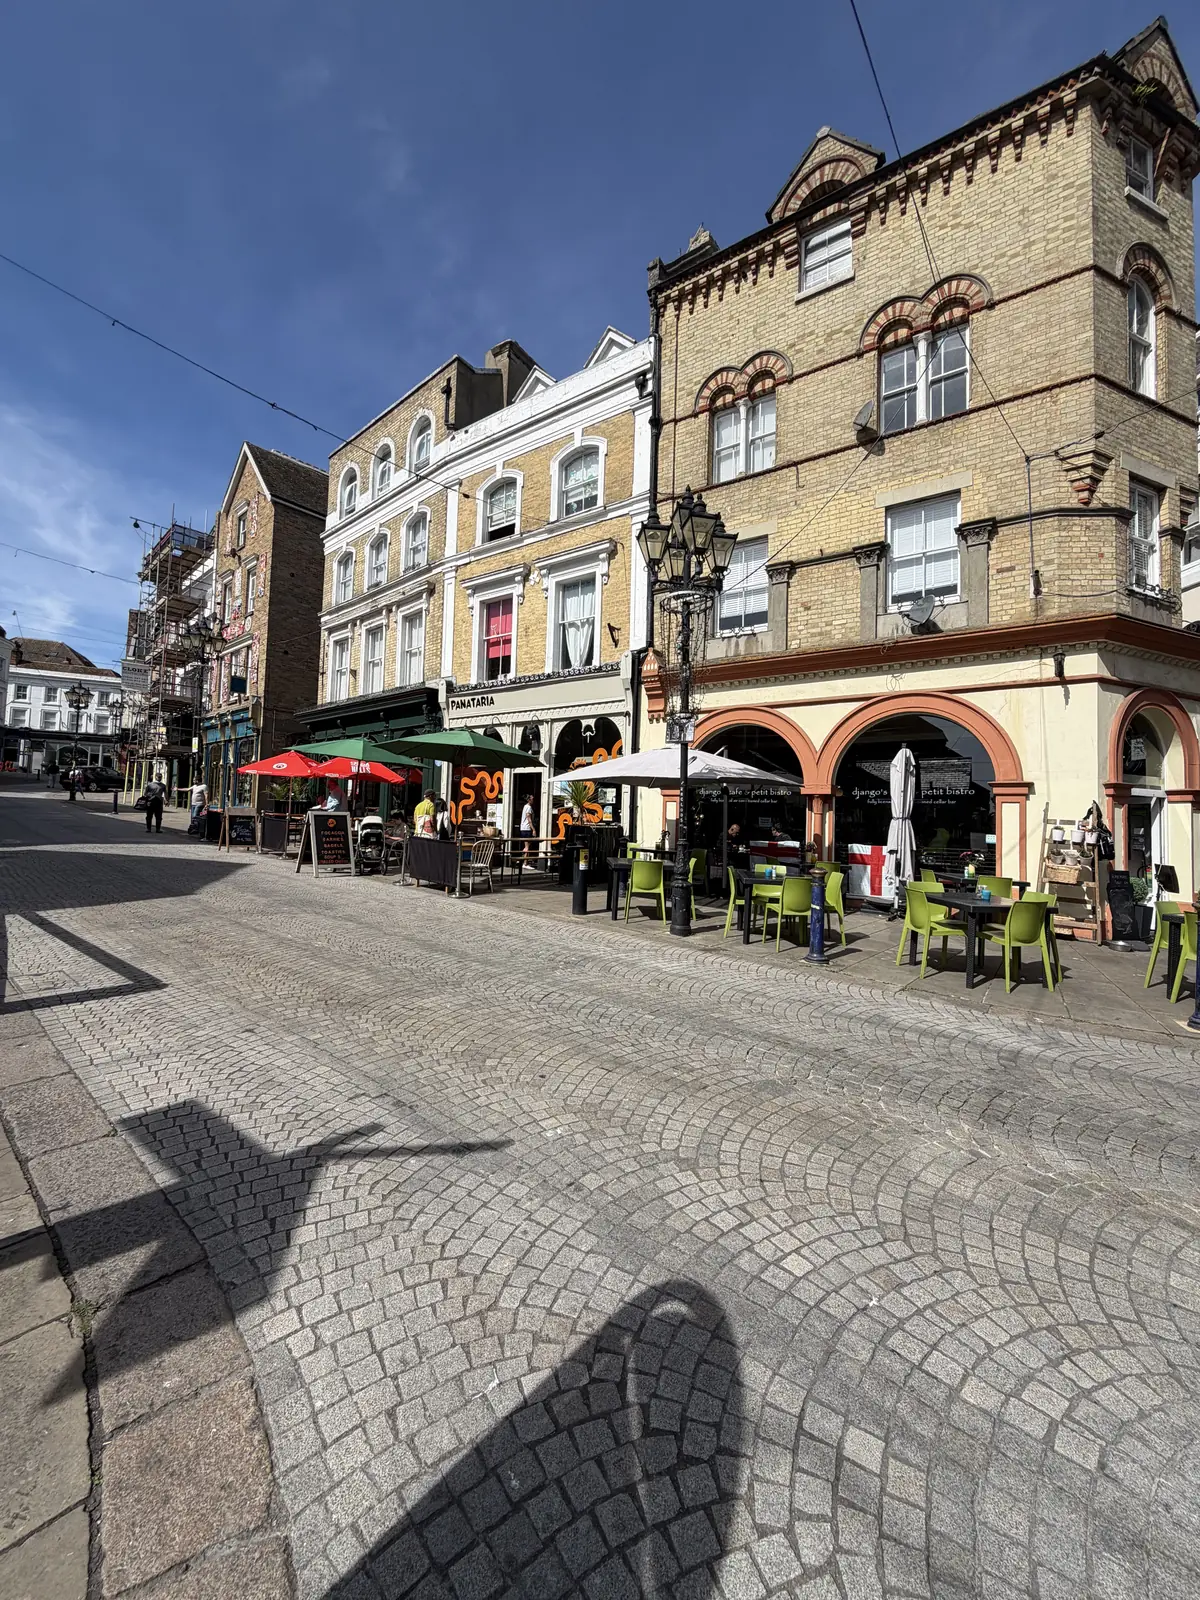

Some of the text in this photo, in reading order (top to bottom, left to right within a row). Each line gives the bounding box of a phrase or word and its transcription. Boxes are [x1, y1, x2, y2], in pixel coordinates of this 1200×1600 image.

[450, 696, 495, 710] PANATARIA
[699, 787, 722, 798] django
[751, 788, 768, 798] petit
[770, 787, 792, 796] bistro
[851, 786, 976, 800] django's petit bistro
